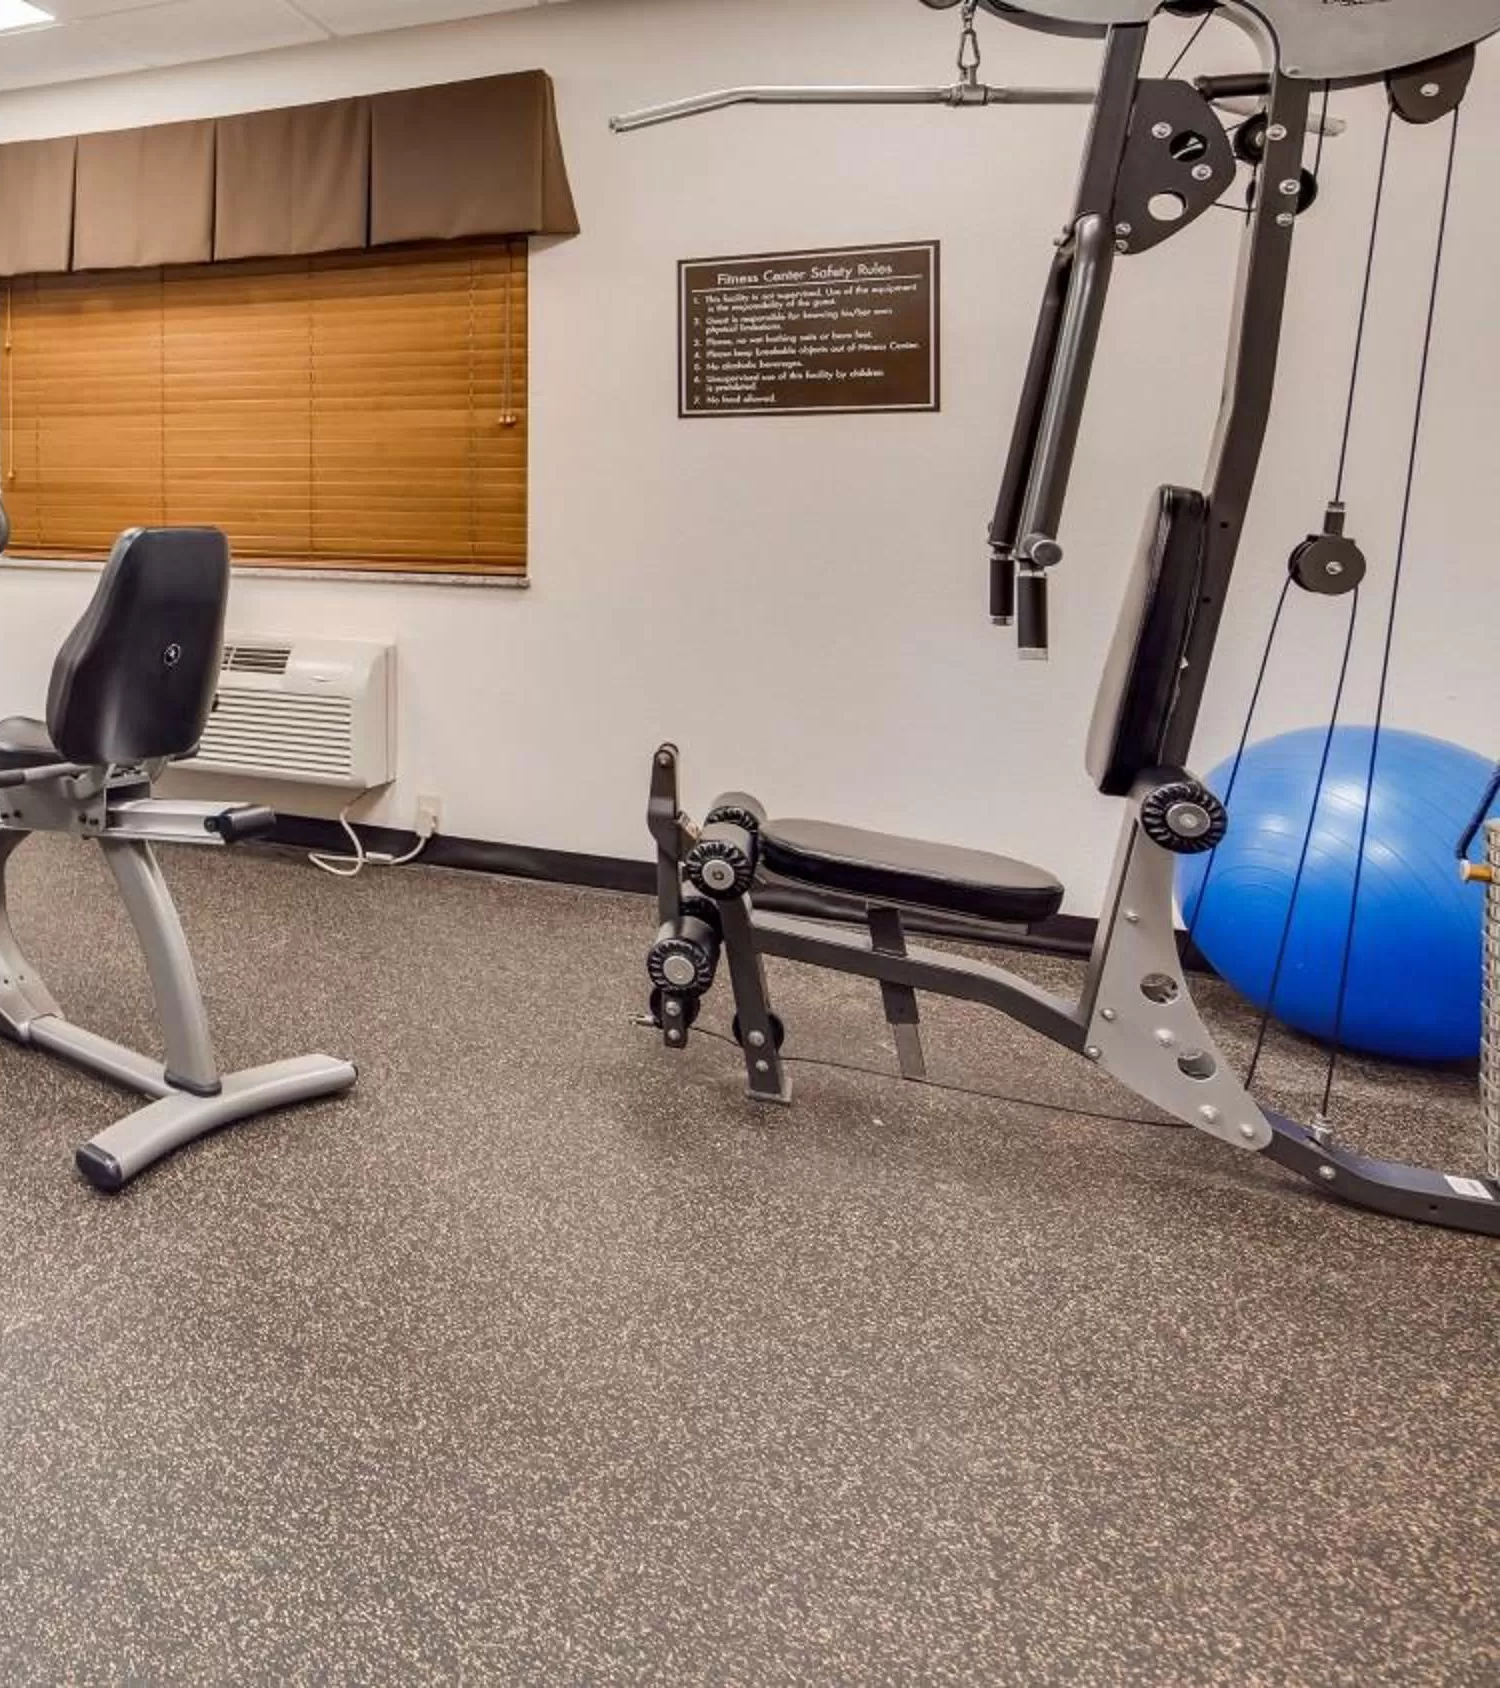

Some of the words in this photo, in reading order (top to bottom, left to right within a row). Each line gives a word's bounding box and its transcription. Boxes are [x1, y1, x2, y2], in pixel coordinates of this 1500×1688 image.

[717, 274, 759, 285] Fitness
[763, 269, 806, 282] Center
[811, 265, 852, 280] Safety
[857, 262, 892, 275] Rules
[705, 294, 721, 304] This
[723, 292, 749, 303] facility
[825, 287, 841, 296] Use
[844, 286, 853, 295] of
[855, 285, 868, 293] the
[871, 283, 917, 295] equipment
[786, 299, 795, 308] of
[740, 312, 786, 324] responsible
[765, 333, 797, 345] bathing
[819, 333, 830, 341] or
[755, 346, 797, 357] breakable
[798, 344, 828, 356] objects
[846, 342, 856, 352] of
[705, 361, 720, 371] No
[777, 371, 787, 380] of
[805, 369, 833, 381] facility
[835, 368, 847, 380] by
